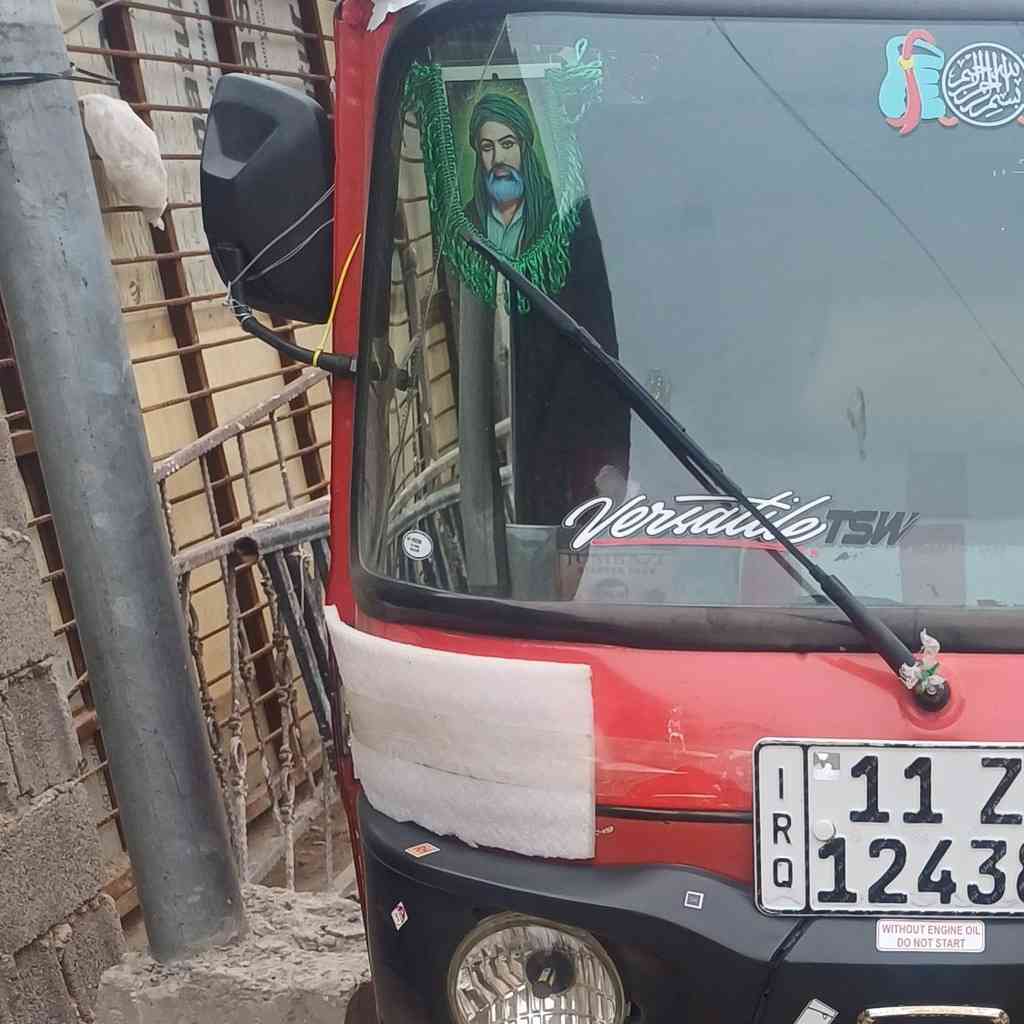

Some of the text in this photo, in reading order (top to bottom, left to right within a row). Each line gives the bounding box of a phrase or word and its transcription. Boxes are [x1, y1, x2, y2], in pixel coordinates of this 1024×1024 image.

[824, 510, 920, 546] TSW
[850, 755, 1023, 825] 11 Z
[772, 767, 793, 889] IRQ
[881, 924, 981, 936] WITHOUT ENGINE OIL
[896, 937, 966, 948] DO NOT START
